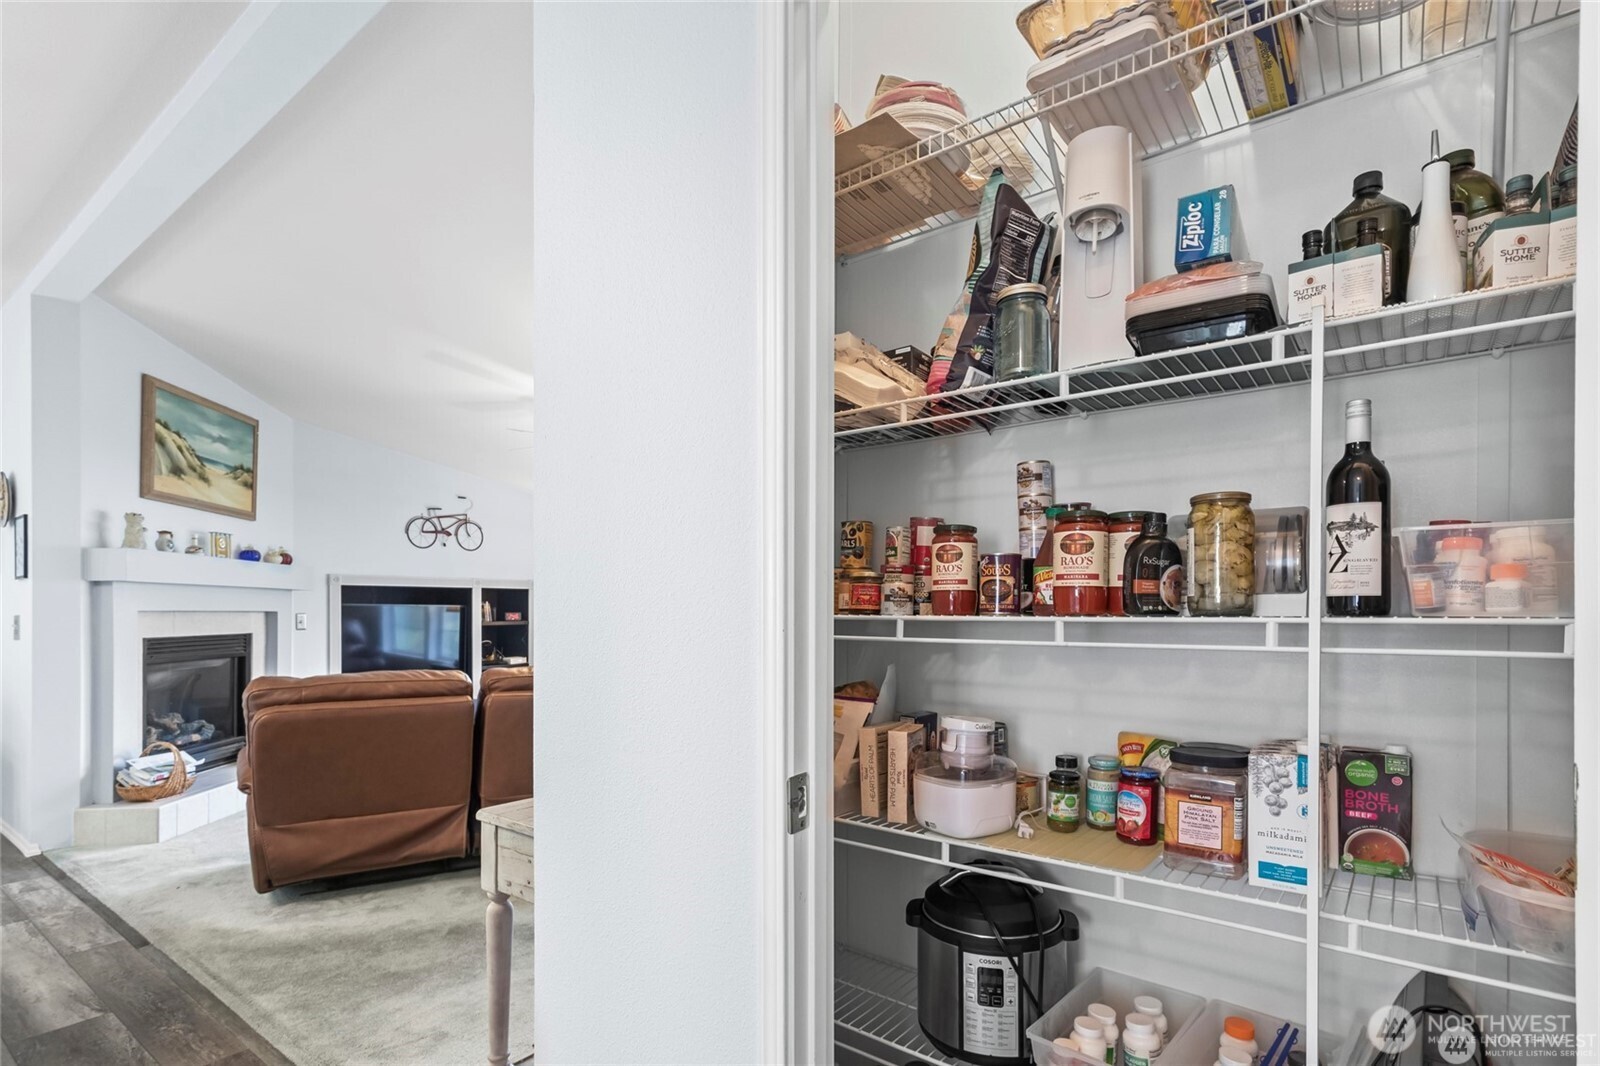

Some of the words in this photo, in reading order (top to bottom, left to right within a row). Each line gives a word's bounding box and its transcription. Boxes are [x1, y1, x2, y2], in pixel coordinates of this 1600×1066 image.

[1219, 190, 1227, 200] 28
[1214, 202, 1222, 236] CONGELAR
[1182, 202, 1205, 248] Ziploc
[1500, 246, 1541, 257] SUTTER
[1505, 254, 1536, 264] HOME
[1293, 284, 1327, 297] SUTTER
[1297, 291, 1322, 302] HOME
[1060, 556, 1094, 566] RAO'S
[1142, 556, 1170, 568] RxSugar
[936, 564, 963, 572] RAO'S
[890, 776, 896, 787] OF
[1344, 789, 1390, 802] BONE
[1186, 806, 1214, 814] GROUND
[1344, 798, 1399, 814] BROTH
[1183, 810, 1217, 818] HIMALAYAN
[1350, 810, 1372, 819] BEEF
[1258, 831, 1307, 843] milkadami
[1266, 845, 1304, 854] UNSWEETENED
